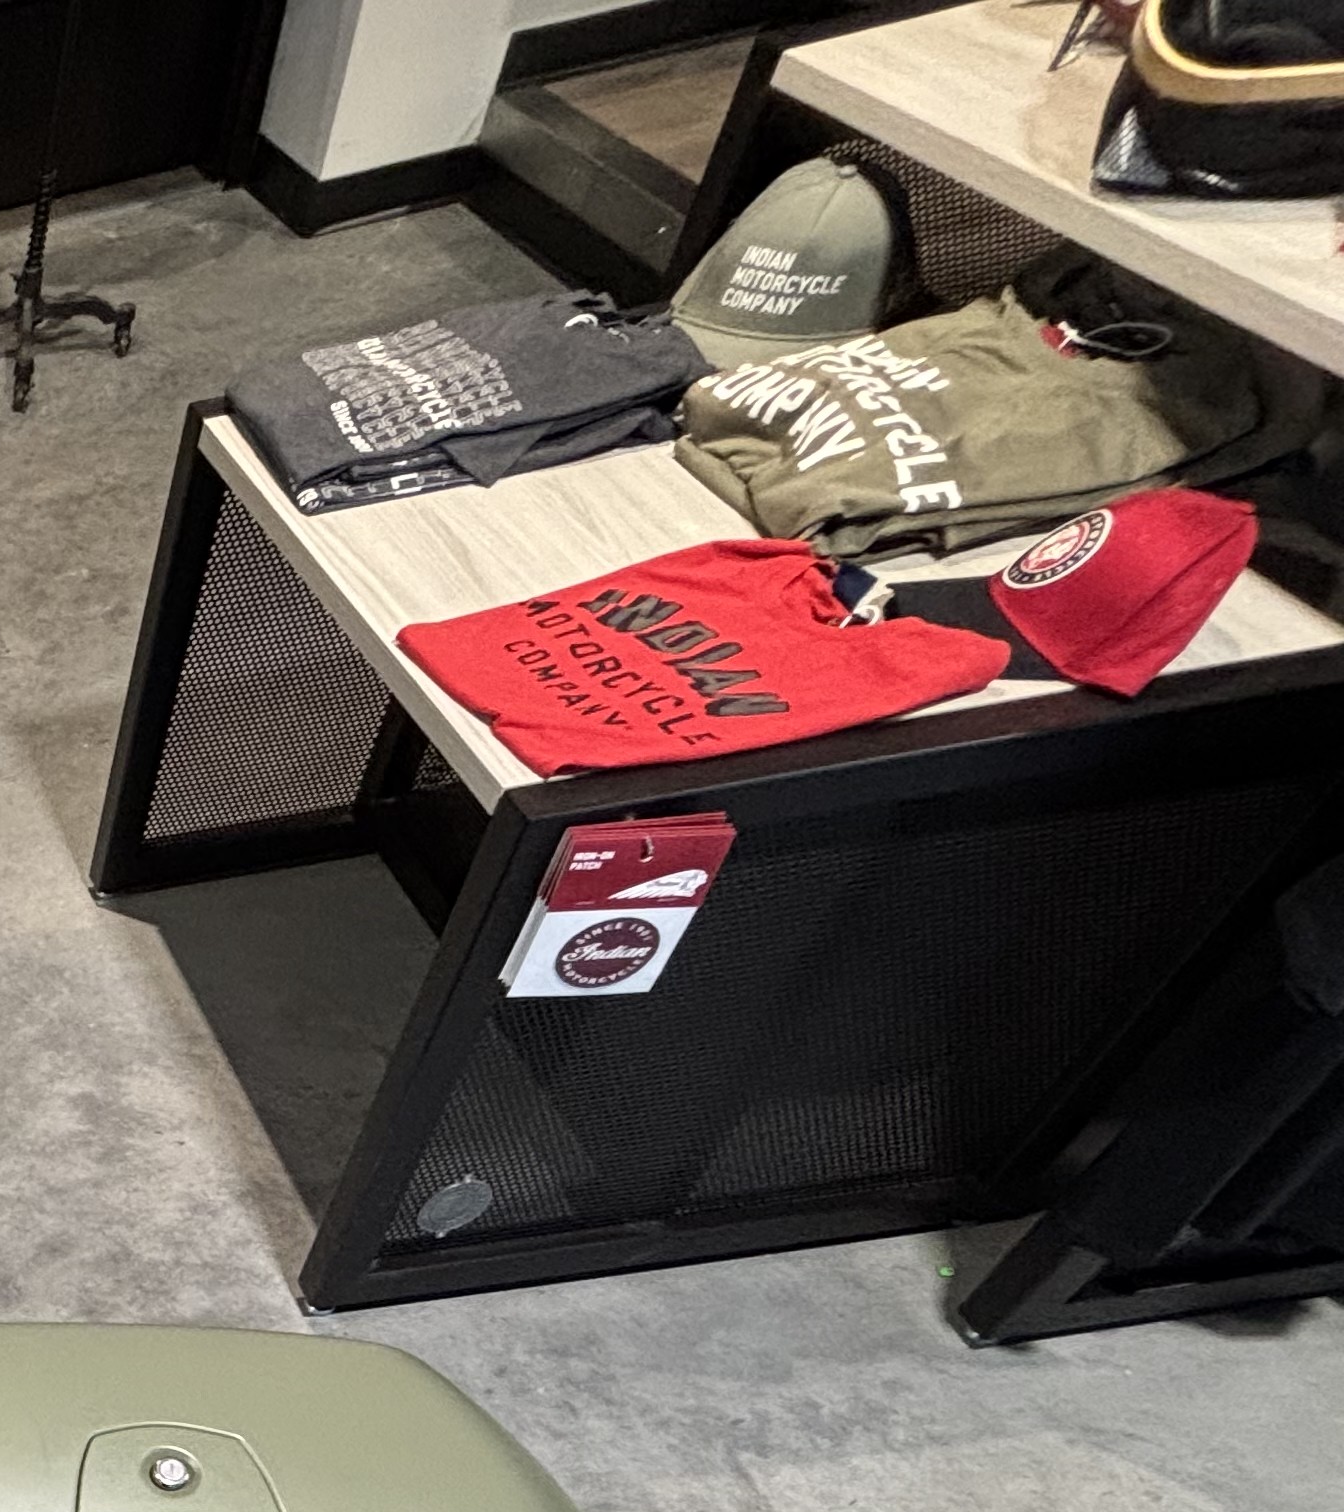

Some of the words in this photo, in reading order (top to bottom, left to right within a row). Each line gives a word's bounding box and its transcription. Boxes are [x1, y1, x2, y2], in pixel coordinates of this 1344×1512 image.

[741, 244, 798, 272] INDIAN
[730, 265, 848, 295] MOTORCYCLE
[720, 287, 805, 316] COMPANY
[577, 588, 790, 718] INDIAN
[503, 639, 627, 727] COMPANY
[518, 598, 722, 746] MOTORCYCLE
[569, 861, 603, 870] PATCH
[575, 921, 623, 945] SINCE
[562, 941, 652, 962] Indian
[562, 958, 642, 985] MOTORCYCLE
